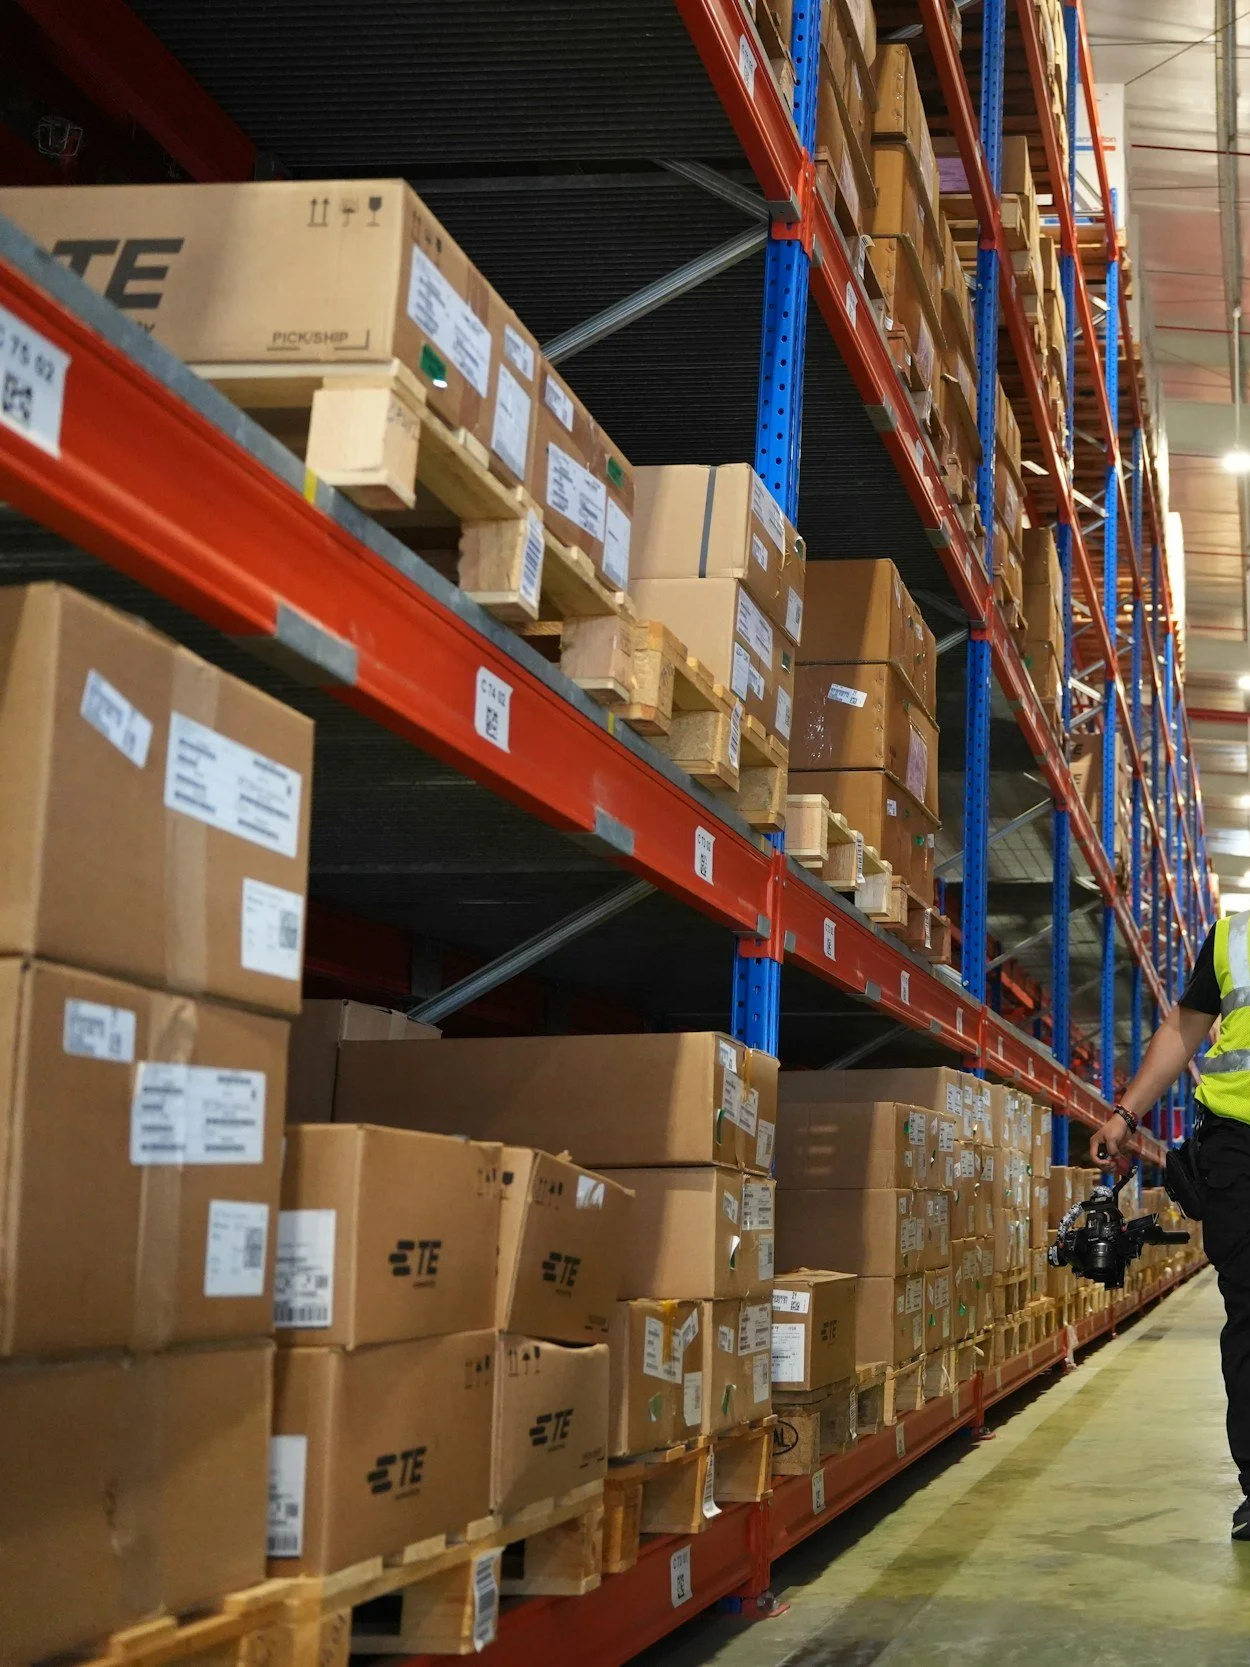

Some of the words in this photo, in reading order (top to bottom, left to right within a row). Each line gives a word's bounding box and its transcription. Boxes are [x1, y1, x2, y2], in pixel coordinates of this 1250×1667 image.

[51, 237, 184, 309] TE
[272, 330, 348, 345] PICK/SHIP
[481, 679, 487, 693] C
[417, 1239, 442, 1276] TE
[560, 1255, 581, 1287] TE
[553, 1407, 574, 1442] TE
[400, 1446, 427, 1488] TE
